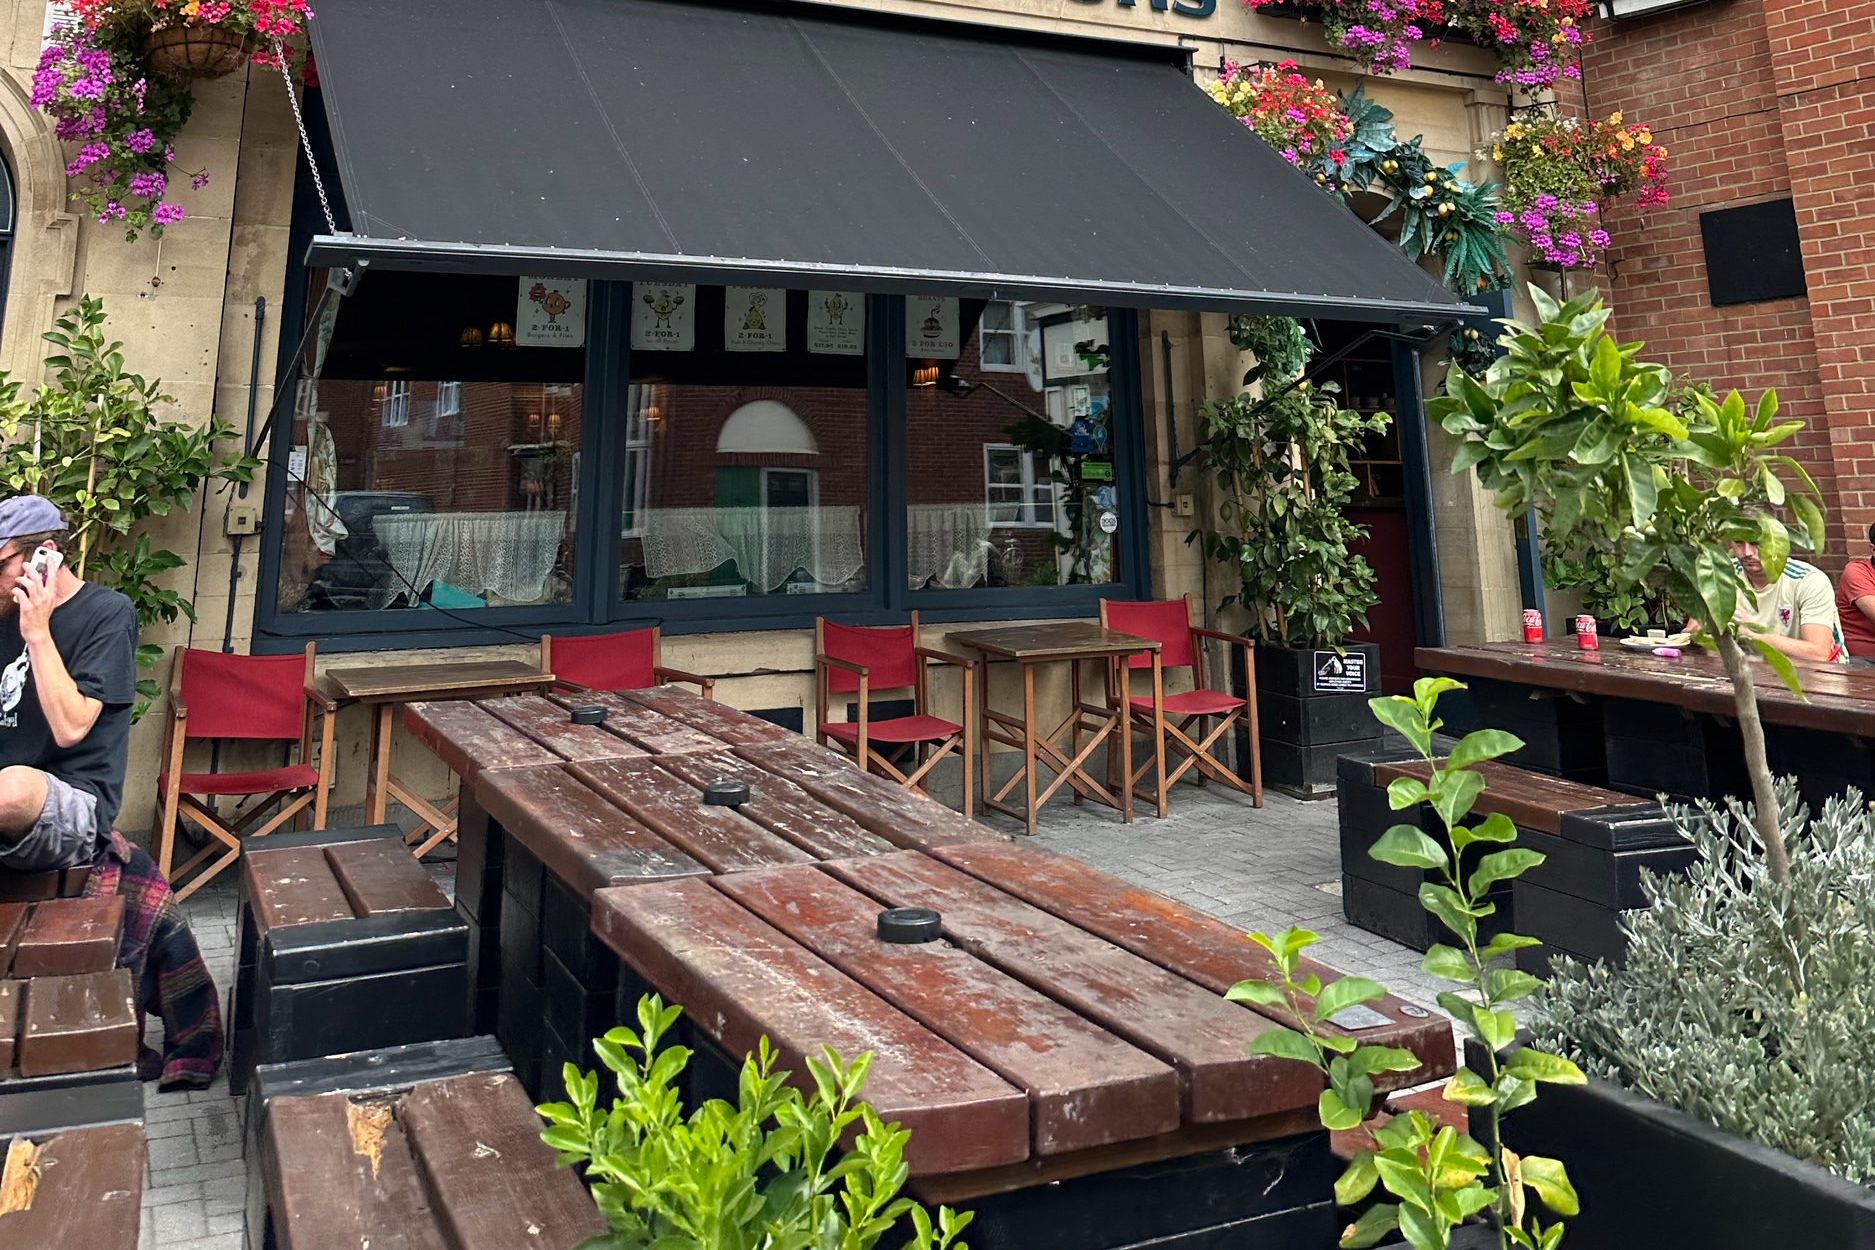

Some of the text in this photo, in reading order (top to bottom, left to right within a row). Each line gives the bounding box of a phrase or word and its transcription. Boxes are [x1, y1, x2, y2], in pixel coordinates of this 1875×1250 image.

[531, 324, 570, 332] 2-FOR-1
[644, 330, 681, 338] 2-FOR-1
[919, 340, 936, 348] FOR
